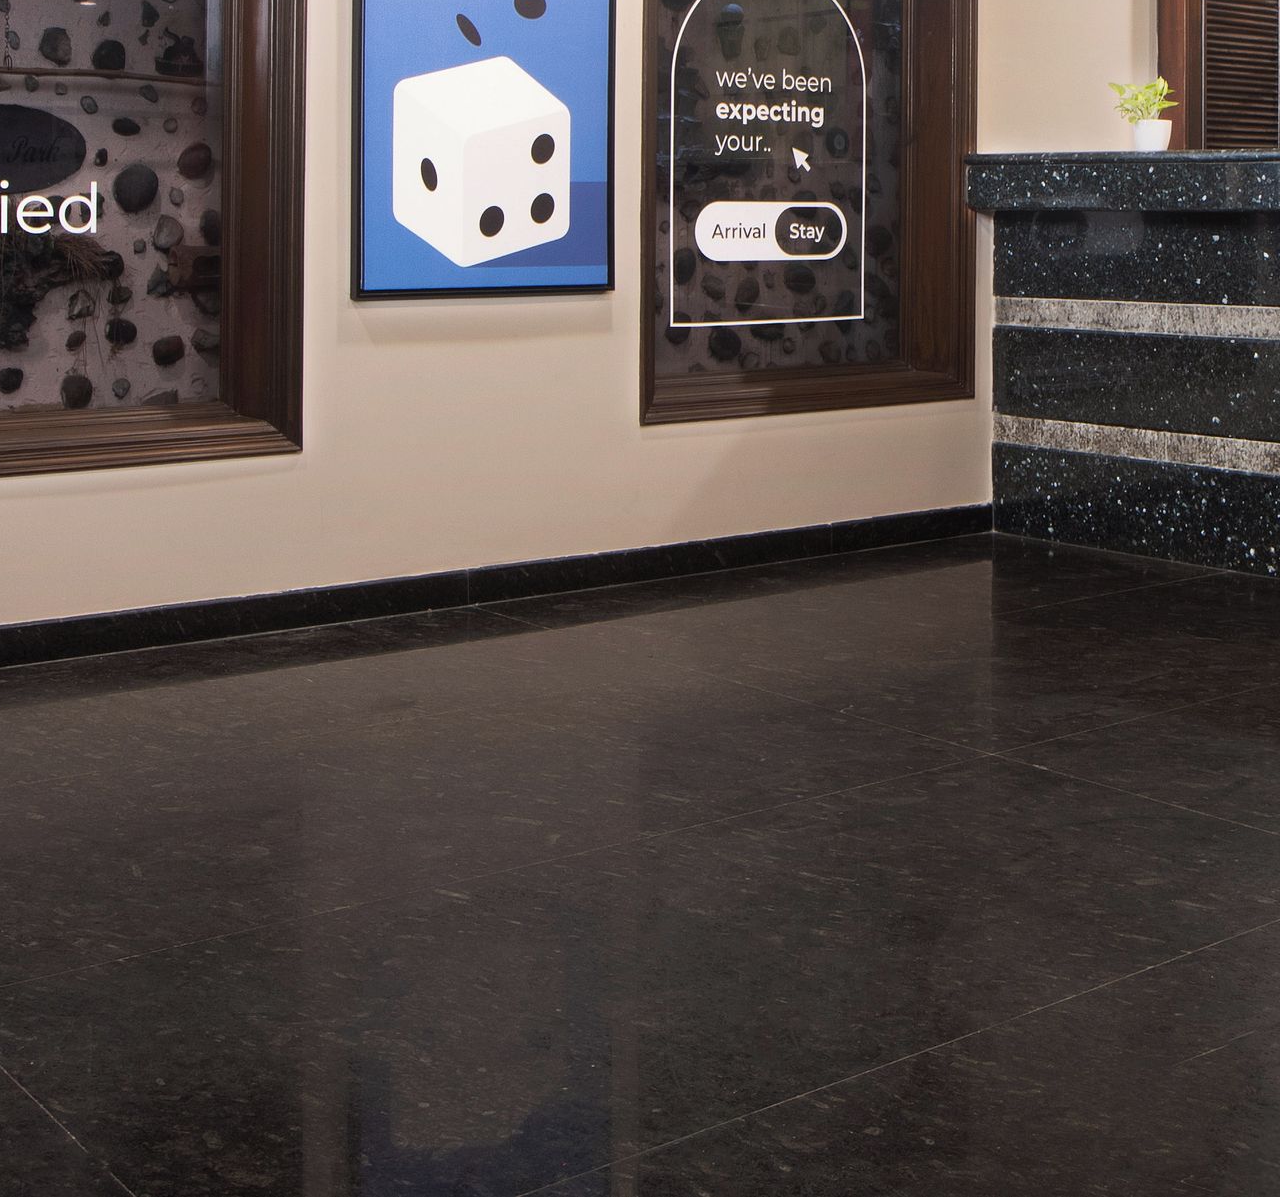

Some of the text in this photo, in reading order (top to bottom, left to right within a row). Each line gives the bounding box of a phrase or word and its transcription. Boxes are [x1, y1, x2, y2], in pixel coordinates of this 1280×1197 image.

[715, 66, 832, 93] we've been
[715, 99, 825, 128] expecting
[6, 135, 61, 165] Park
[714, 132, 772, 156] your..
[711, 222, 826, 242] Arrival Stay
